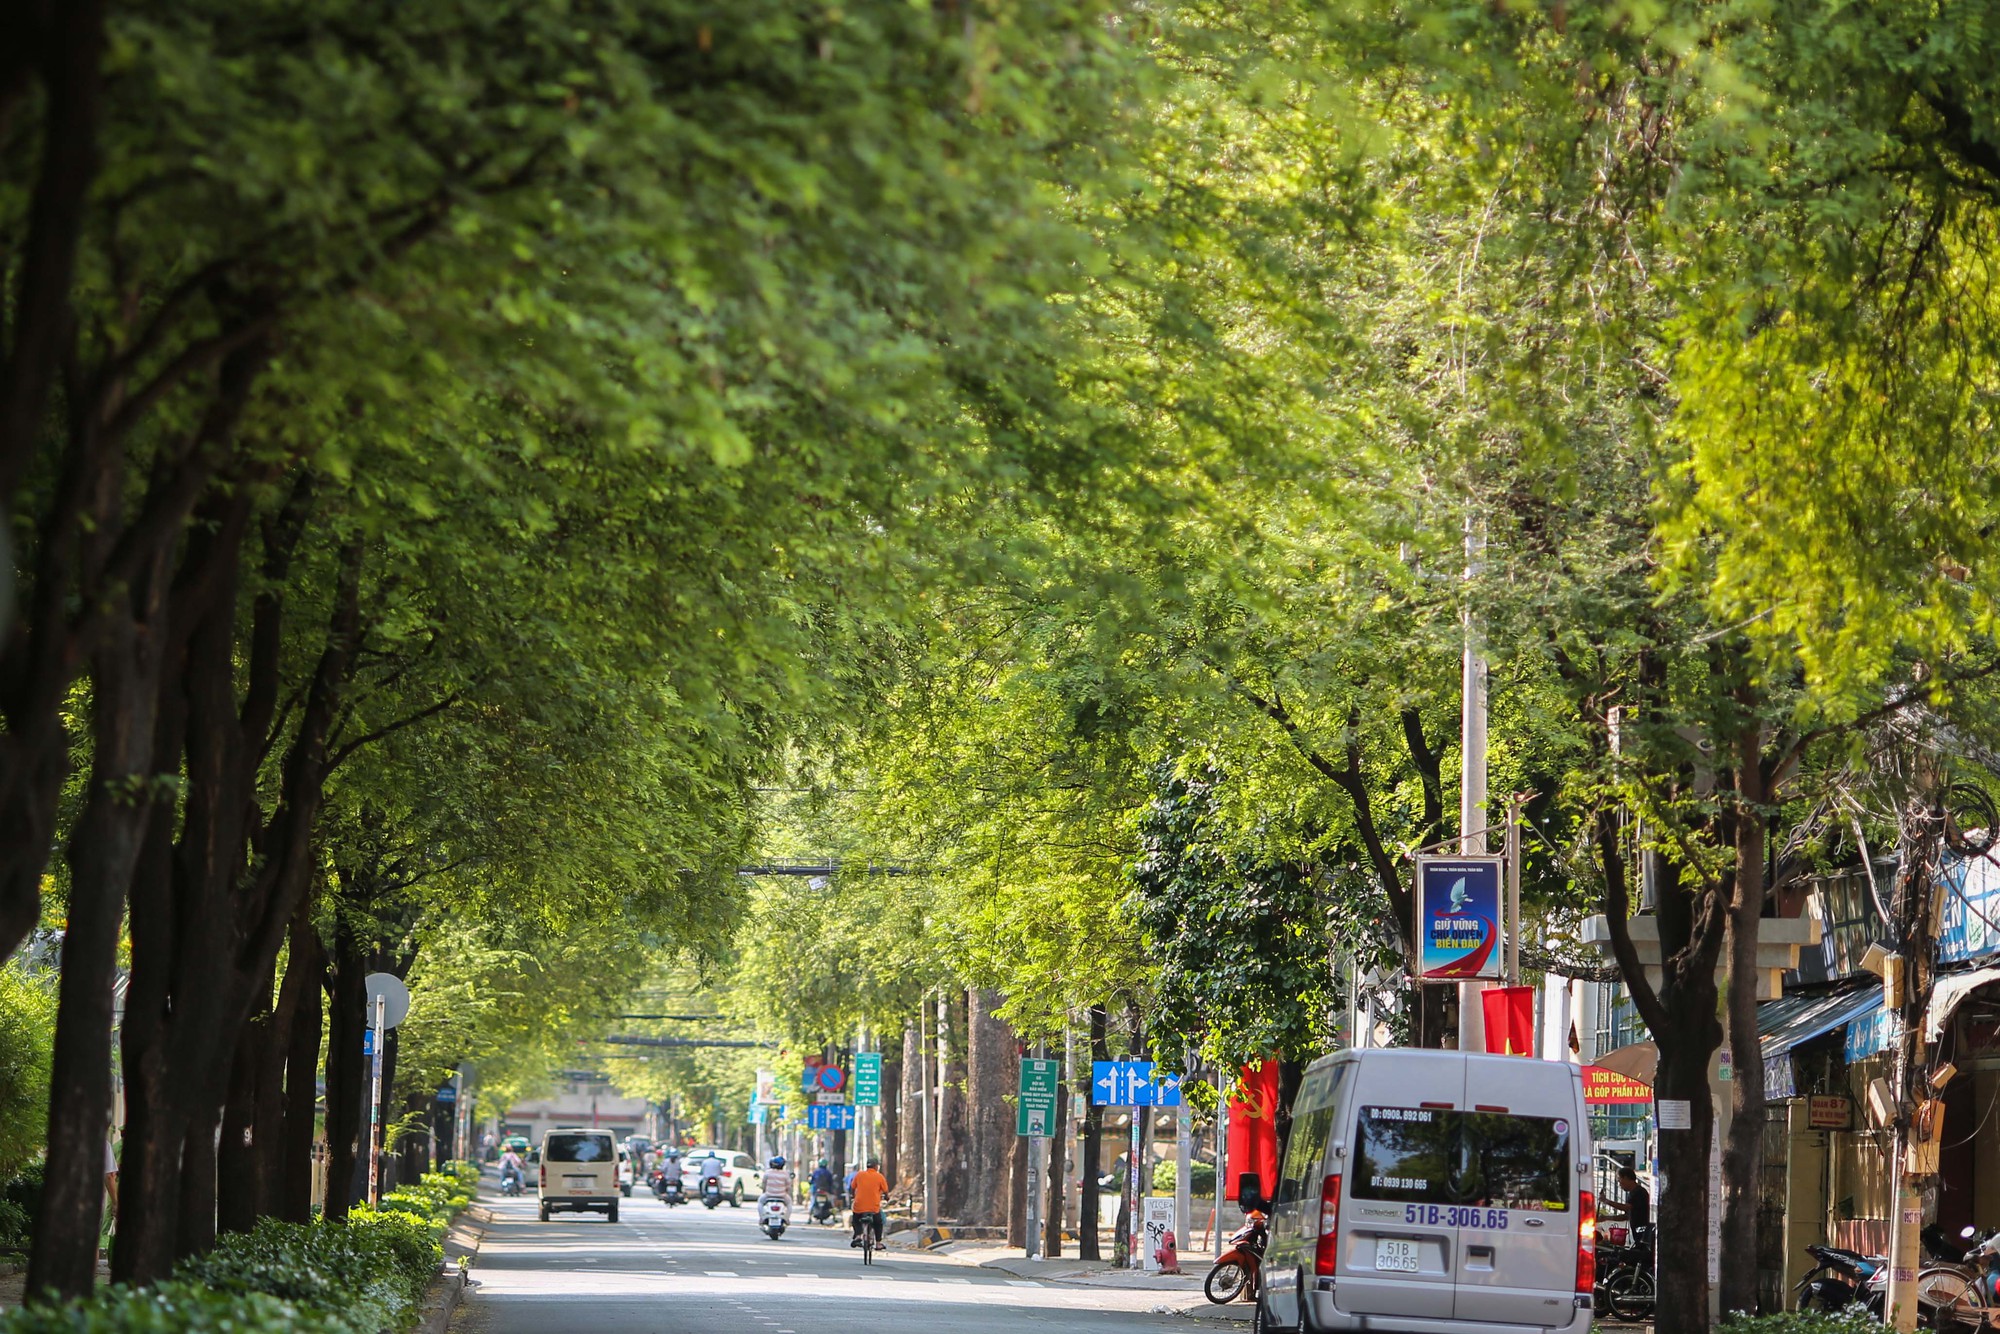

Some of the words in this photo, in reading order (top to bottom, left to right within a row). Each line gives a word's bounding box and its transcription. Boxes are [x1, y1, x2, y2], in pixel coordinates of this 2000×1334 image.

[1434, 917, 1451, 930] GIỮ
[1592, 1070, 1609, 1083] TÍCH
[1583, 1084, 1593, 1098] LÀ
[1594, 1084, 1610, 1098] GÓP
[1634, 1084, 1650, 1098] XÂY
[1830, 1098, 1846, 1109] 87
[1405, 1204, 1509, 1230] 51B-306.65
[1387, 1242, 1409, 1256] 51B
[1378, 1254, 1417, 1270] 306.65
